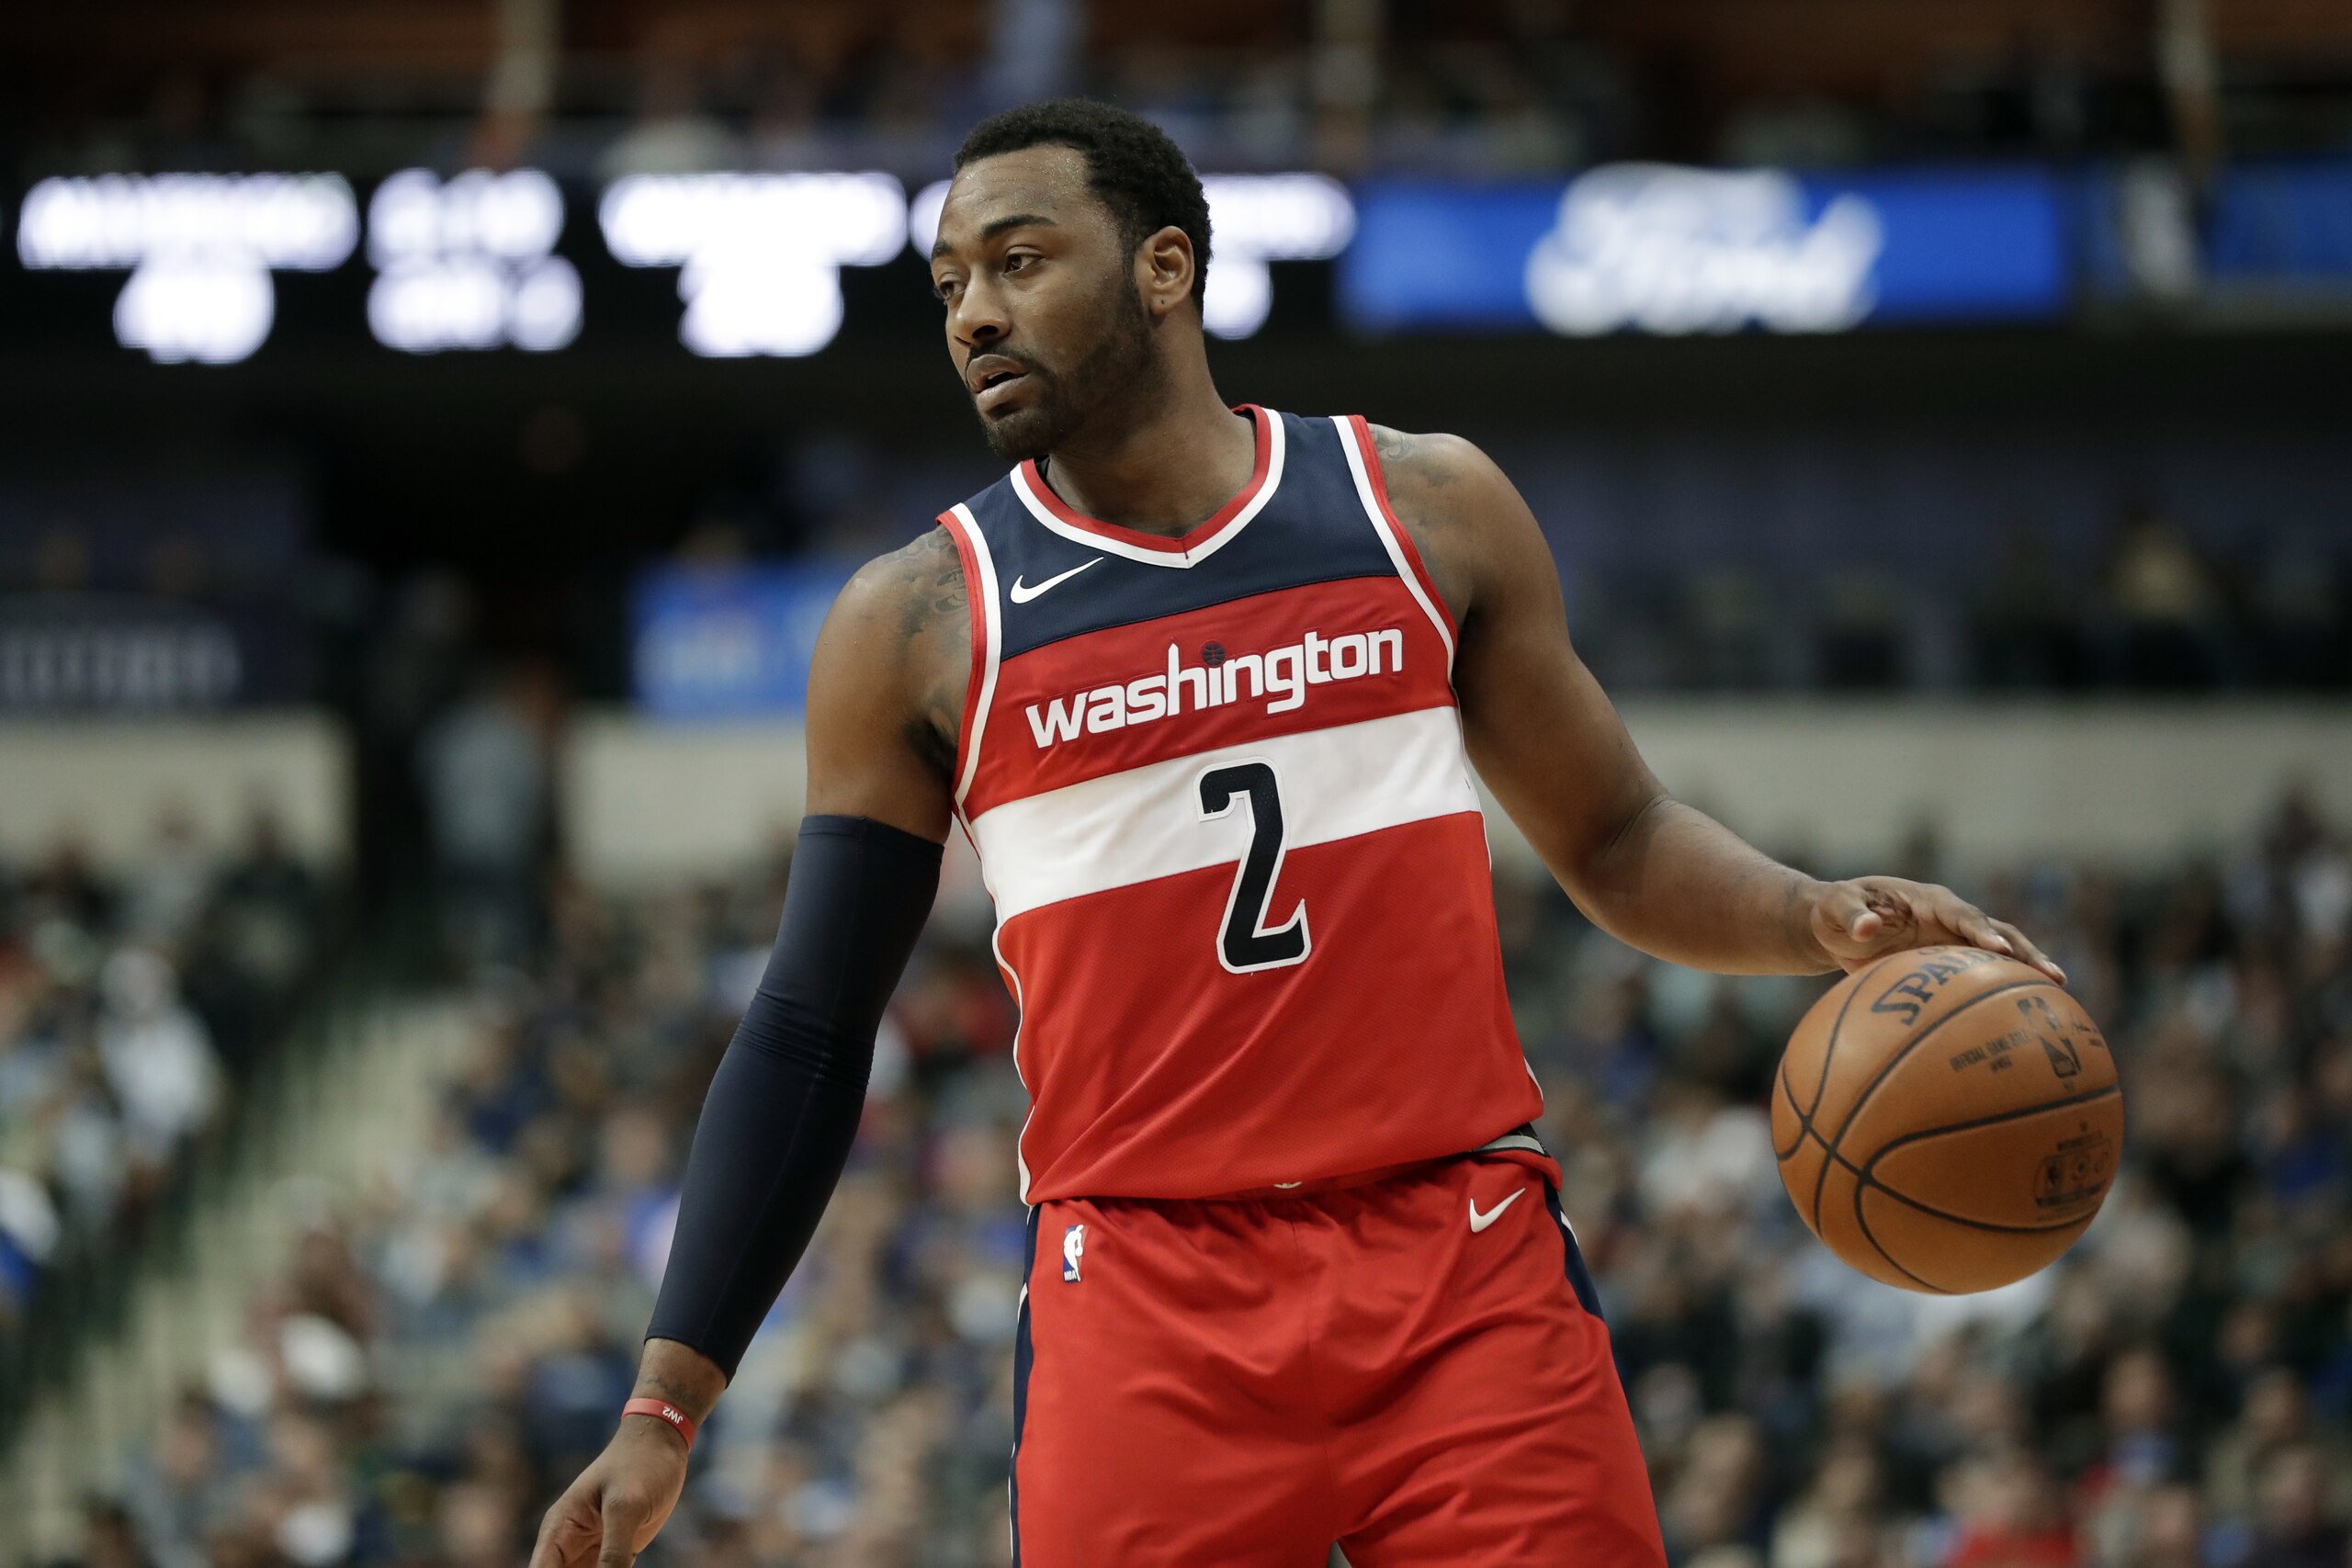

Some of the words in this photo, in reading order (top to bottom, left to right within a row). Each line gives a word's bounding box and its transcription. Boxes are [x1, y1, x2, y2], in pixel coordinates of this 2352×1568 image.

[1025, 628, 1403, 749] washington
[1195, 756, 1312, 975] 2
[662, 1406, 683, 1424] JW2
